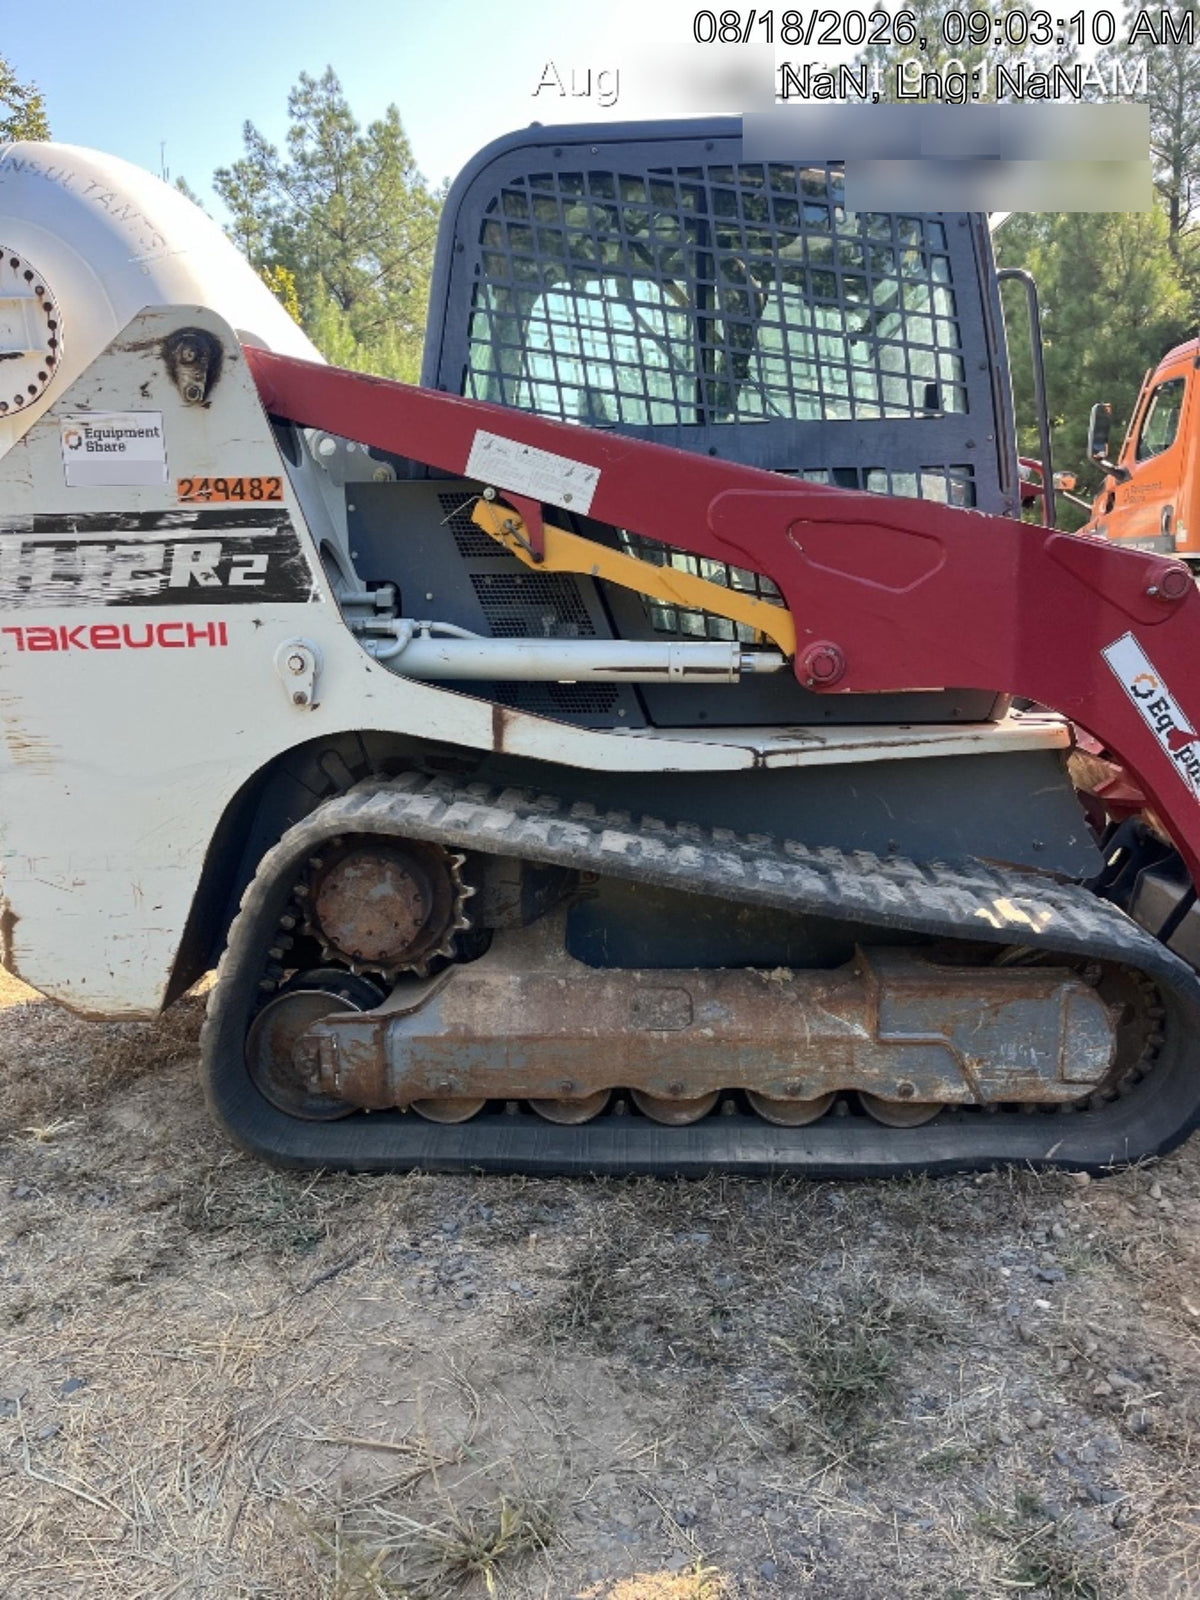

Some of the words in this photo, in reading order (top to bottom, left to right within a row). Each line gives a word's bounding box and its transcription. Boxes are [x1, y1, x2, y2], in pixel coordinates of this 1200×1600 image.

[84, 426, 160, 440] Equipment
[85, 440, 127, 453] Share
[178, 477, 283, 501] 249482
